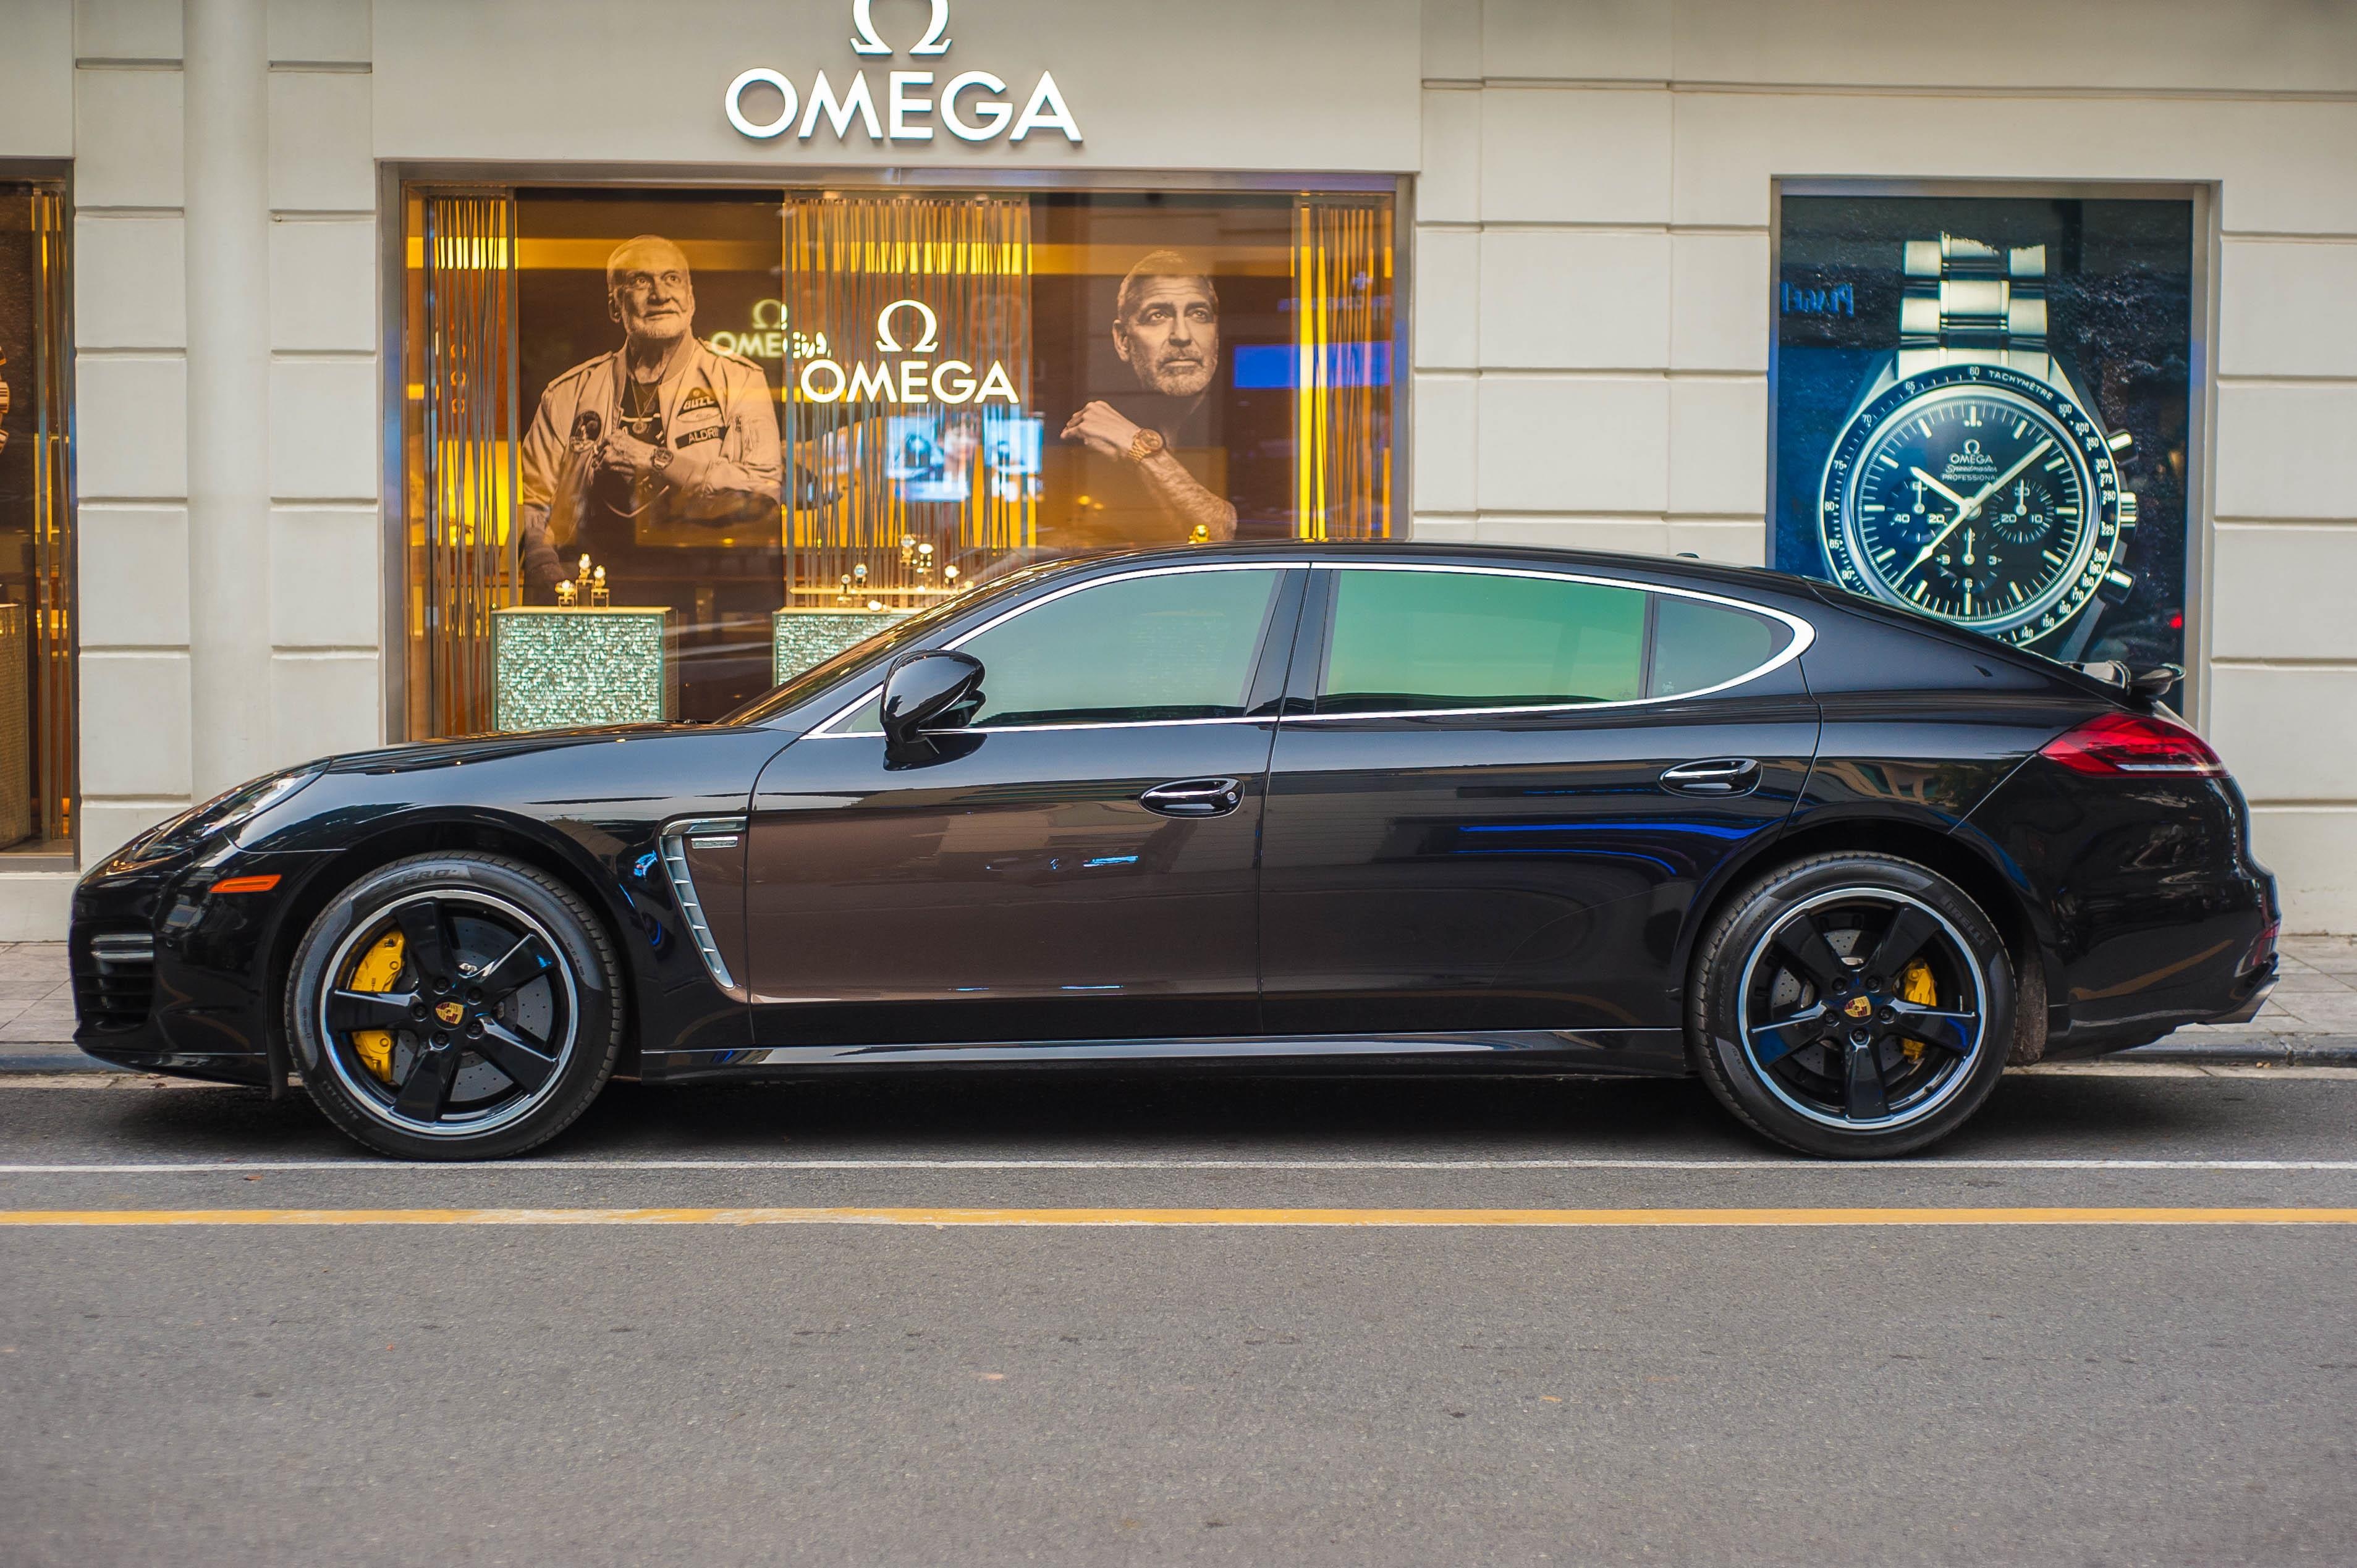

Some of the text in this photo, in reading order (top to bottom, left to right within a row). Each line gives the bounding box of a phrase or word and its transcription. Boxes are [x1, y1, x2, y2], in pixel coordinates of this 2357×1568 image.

[725, 67, 1083, 141] OMEGA
[1970, 366, 1979, 375] 60
[800, 360, 1021, 404] OMEGA
[1905, 381, 1915, 391] 65
[1989, 370, 2053, 401] TACHYMÈTRE
[683, 395, 715, 410] BUZZ
[2059, 403, 2071, 414] 500
[1862, 415, 1872, 424] 70
[2075, 422, 2089, 433] 400
[2086, 437, 2099, 448] 350
[1950, 453, 1993, 465] OMEGA
[2096, 458, 2109, 470] 300
[1834, 460, 1843, 470] 75
[2101, 473, 2113, 484] 275
[2103, 491, 2116, 501] 250
[1825, 501, 1835, 510] 80
[1894, 513, 1910, 523] 40
[1927, 513, 1945, 524] 20
[2000, 514, 2017, 523] 20
[2030, 514, 2043, 523] 10
[2102, 525, 2114, 536] 225
[1829, 539, 1840, 549] 85
[1942, 554, 1951, 565] 9
[1987, 555, 1997, 565] 3
[2094, 551, 2107, 562] 200
[2089, 563, 2102, 575] 190
[1842, 570, 1852, 580] 90
[1963, 578, 1973, 588] 6
[2082, 576, 2094, 588] 180
[2072, 589, 2084, 601] 170
[2059, 603, 2071, 614] 160
[2042, 617, 2055, 627] 150
[2021, 628, 2034, 638] 140
